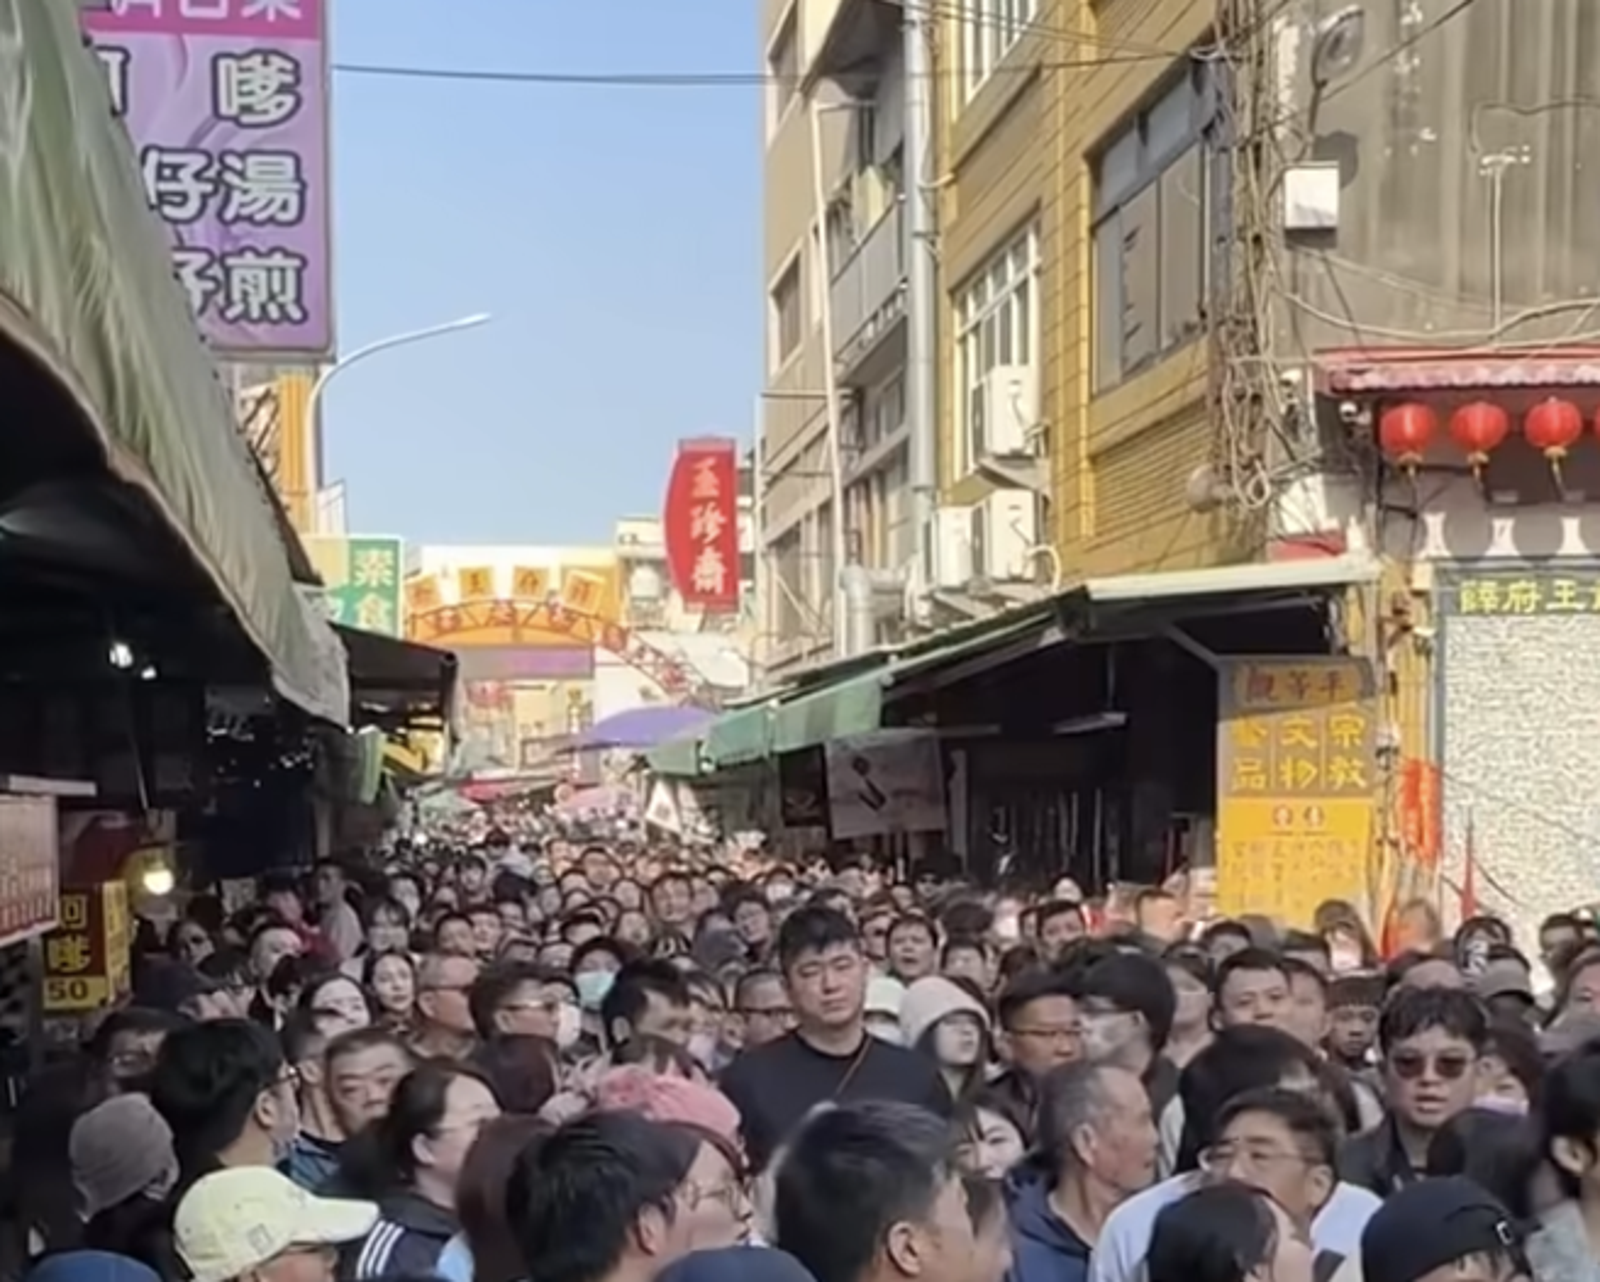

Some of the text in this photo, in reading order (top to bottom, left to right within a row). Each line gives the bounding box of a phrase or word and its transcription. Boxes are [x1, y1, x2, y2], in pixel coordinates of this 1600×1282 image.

[1460, 578, 1600, 614] 薛府王
[48, 977, 90, 1003] 50
